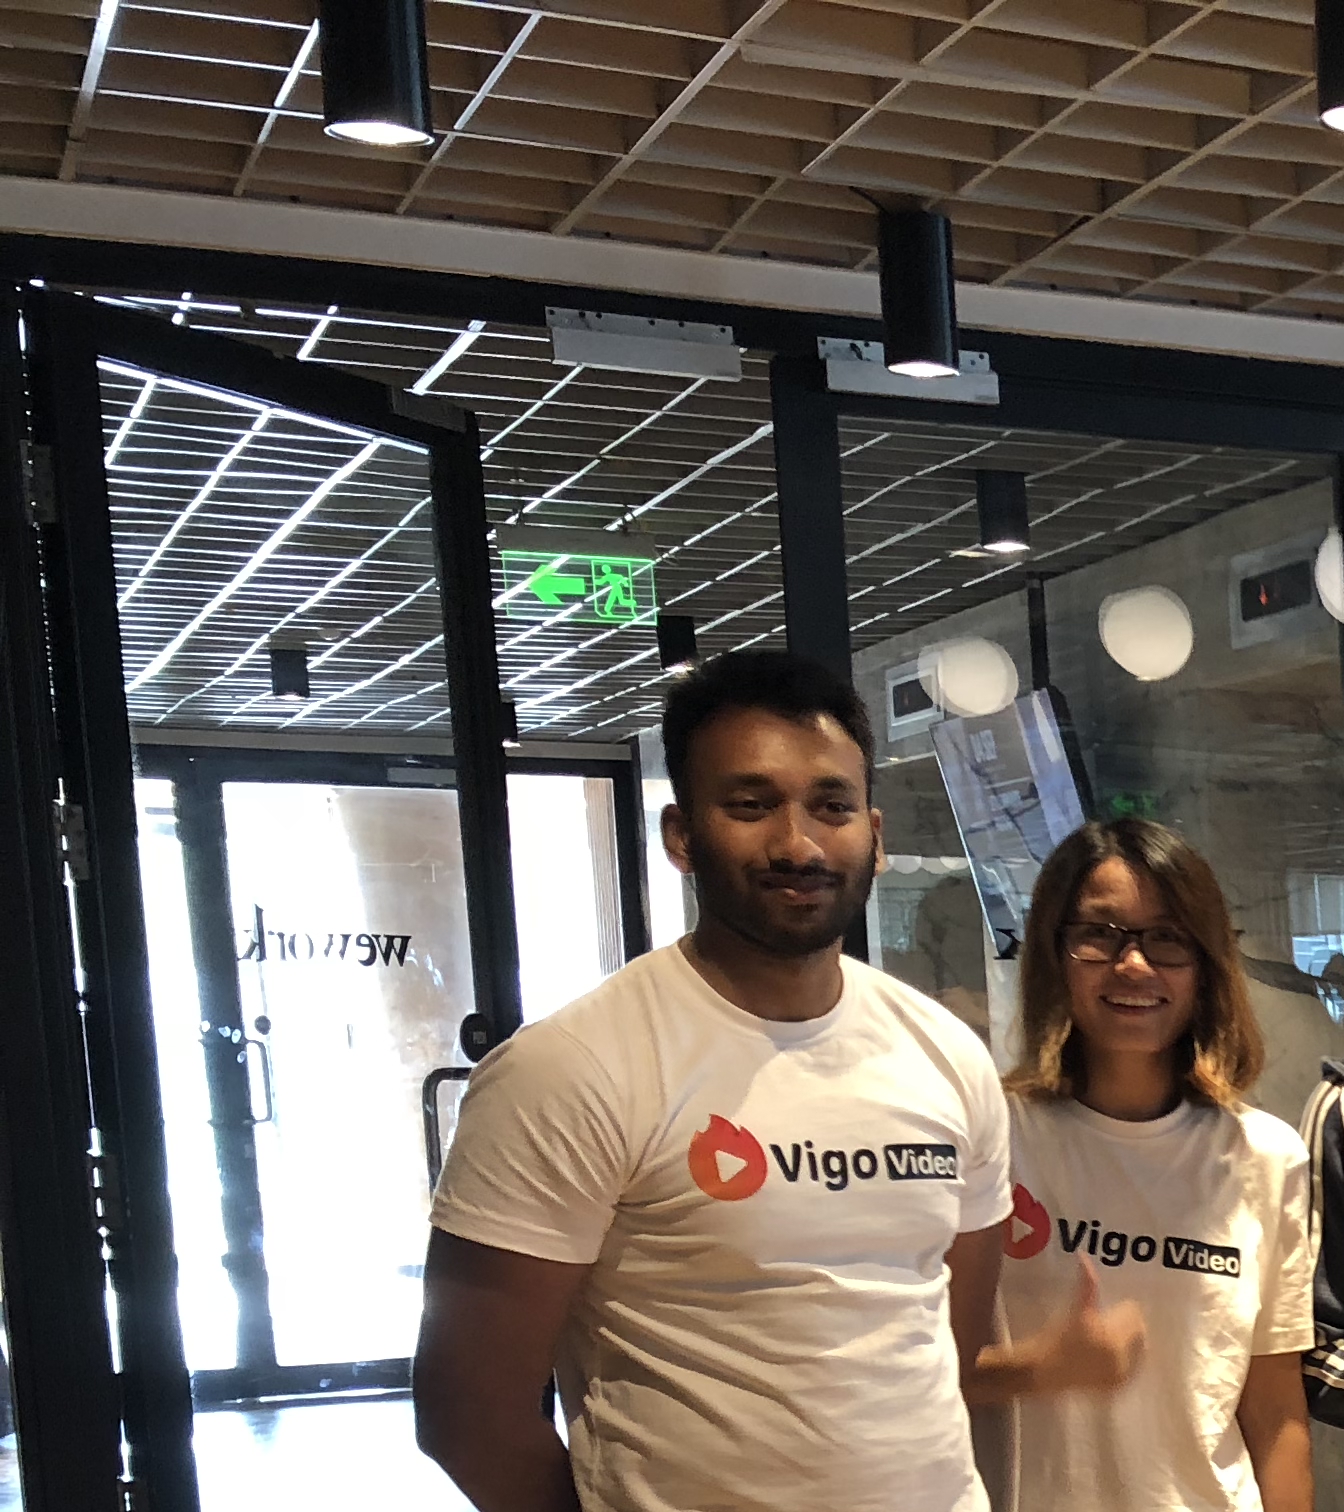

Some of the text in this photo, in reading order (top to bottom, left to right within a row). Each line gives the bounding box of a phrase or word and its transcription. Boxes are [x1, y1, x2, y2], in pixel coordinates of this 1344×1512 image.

[769, 1140, 878, 1191] Vigo
[1057, 1218, 1240, 1275] Vigo Video
